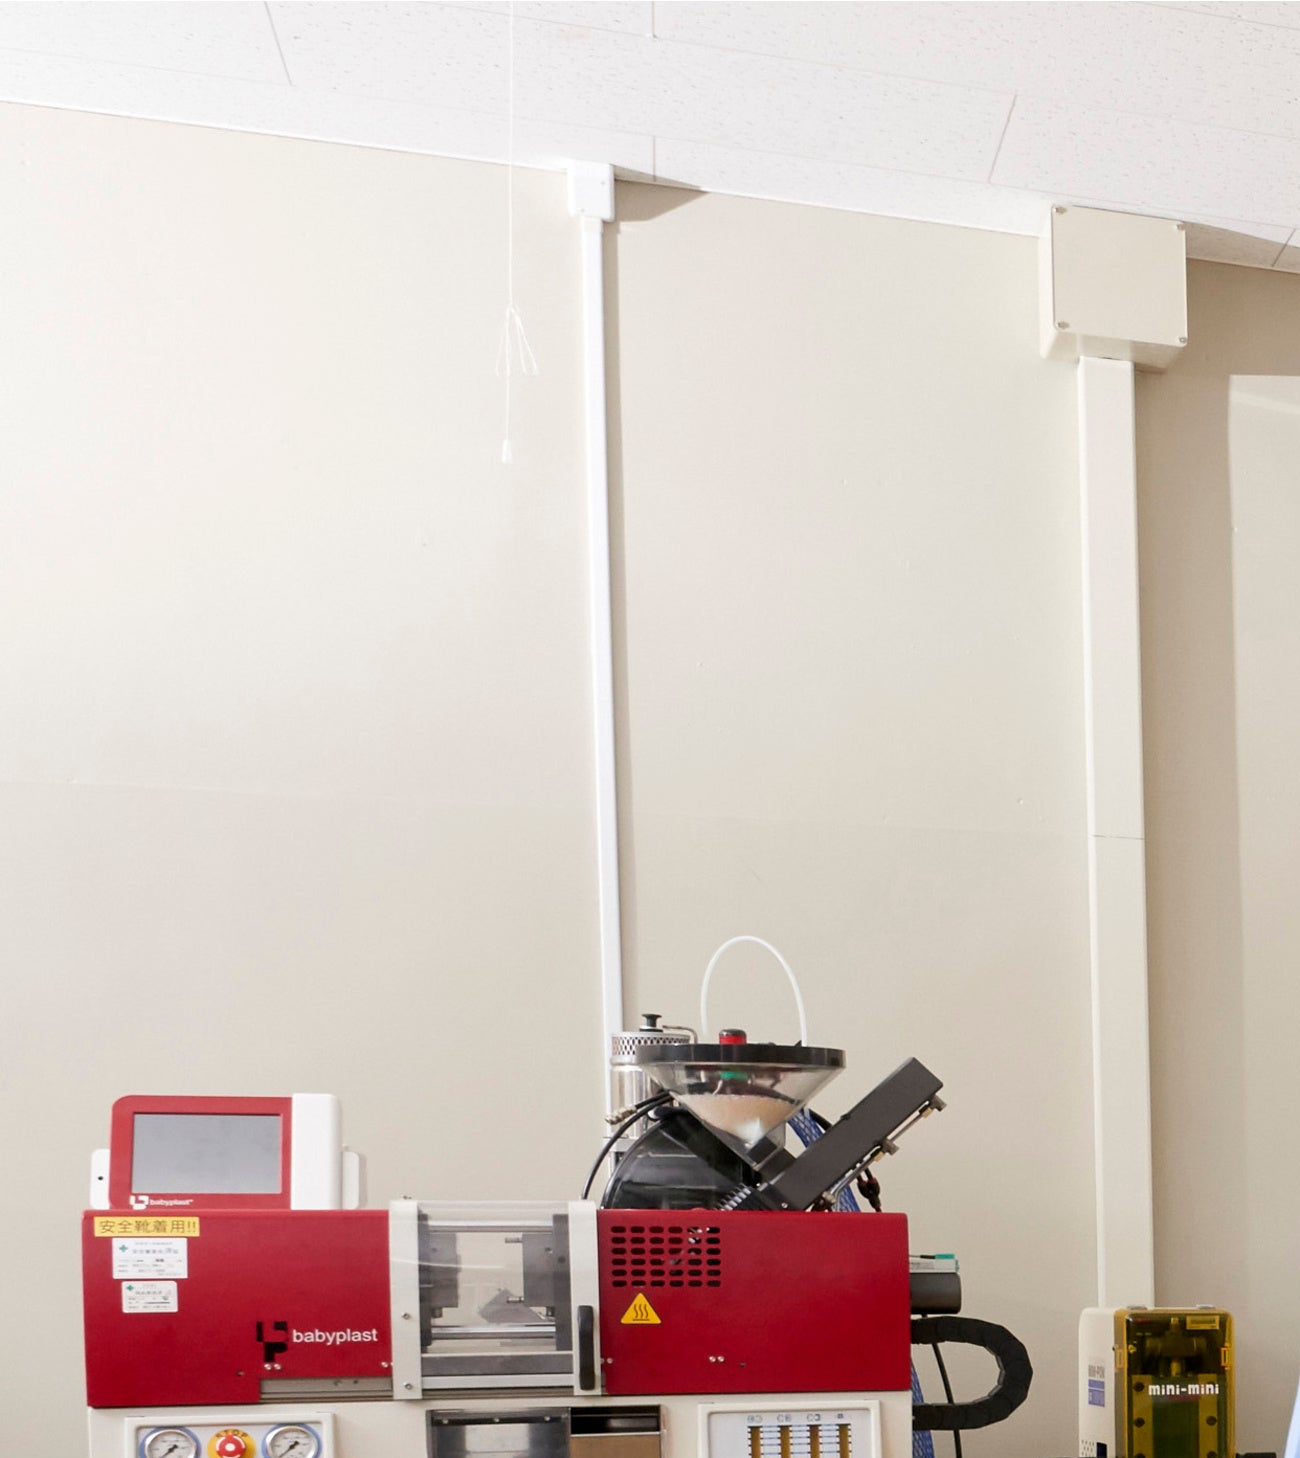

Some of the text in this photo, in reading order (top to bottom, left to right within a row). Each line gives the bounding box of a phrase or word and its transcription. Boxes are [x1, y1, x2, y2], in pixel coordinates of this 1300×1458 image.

[99, 1220, 196, 1233] 安全靴着用!!
[292, 1328, 378, 1346] babyplast
[1148, 1383, 1219, 1396] mini-mini
